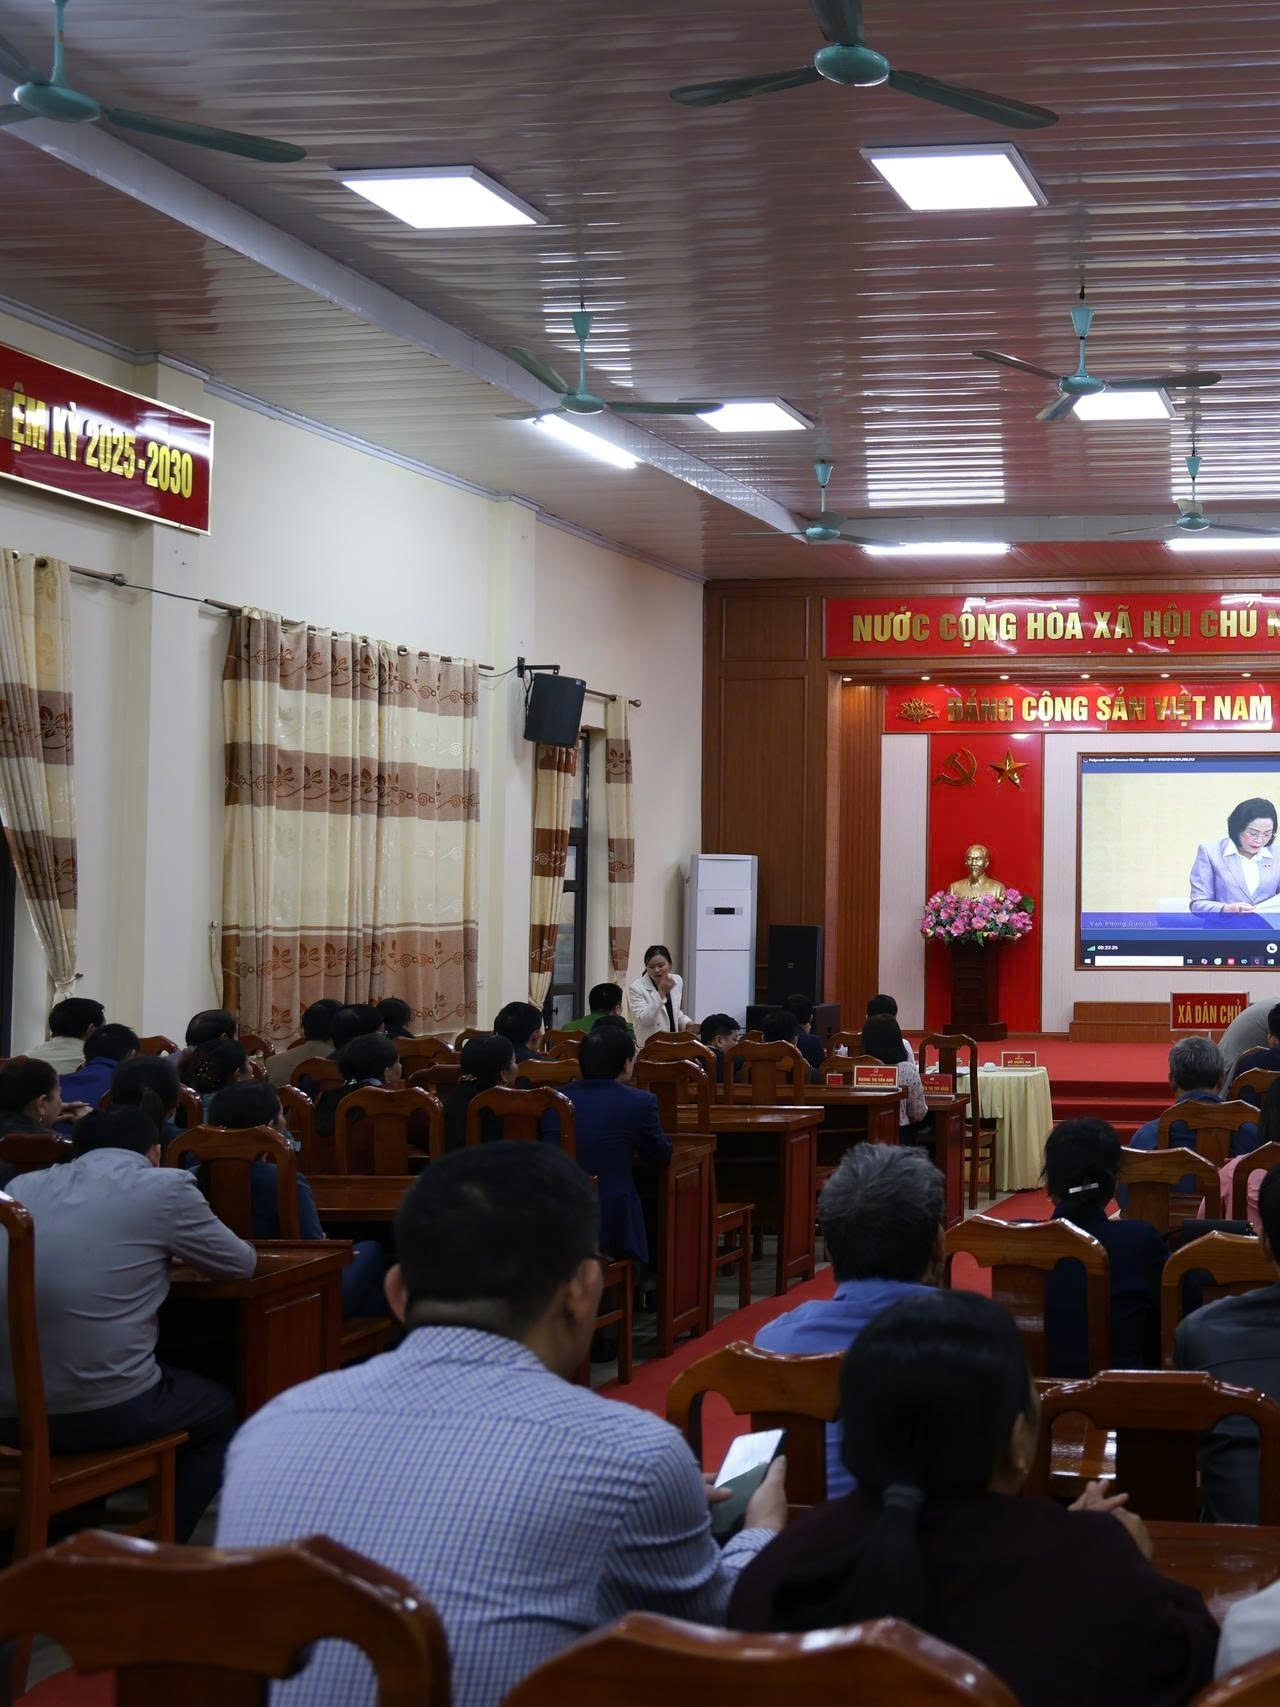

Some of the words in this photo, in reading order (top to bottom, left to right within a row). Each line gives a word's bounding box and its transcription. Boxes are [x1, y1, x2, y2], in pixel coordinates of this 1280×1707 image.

[852, 606, 930, 642] NƯỚC
[939, 607, 1018, 647] CỘNG
[1026, 606, 1083, 640] HÒA
[1093, 606, 1133, 640] XÃ
[1143, 604, 1191, 645] HỘI
[947, 687, 1014, 722] ĐẢNG
[1021, 691, 1088, 727] CỘNG
[1096, 687, 1146, 722] SẢN
[1152, 688, 1206, 726] VIỆT
[1213, 696, 1272, 722] NAM
[1178, 1002, 1193, 1024] XÃ
[1195, 1001, 1217, 1024] DÂN
